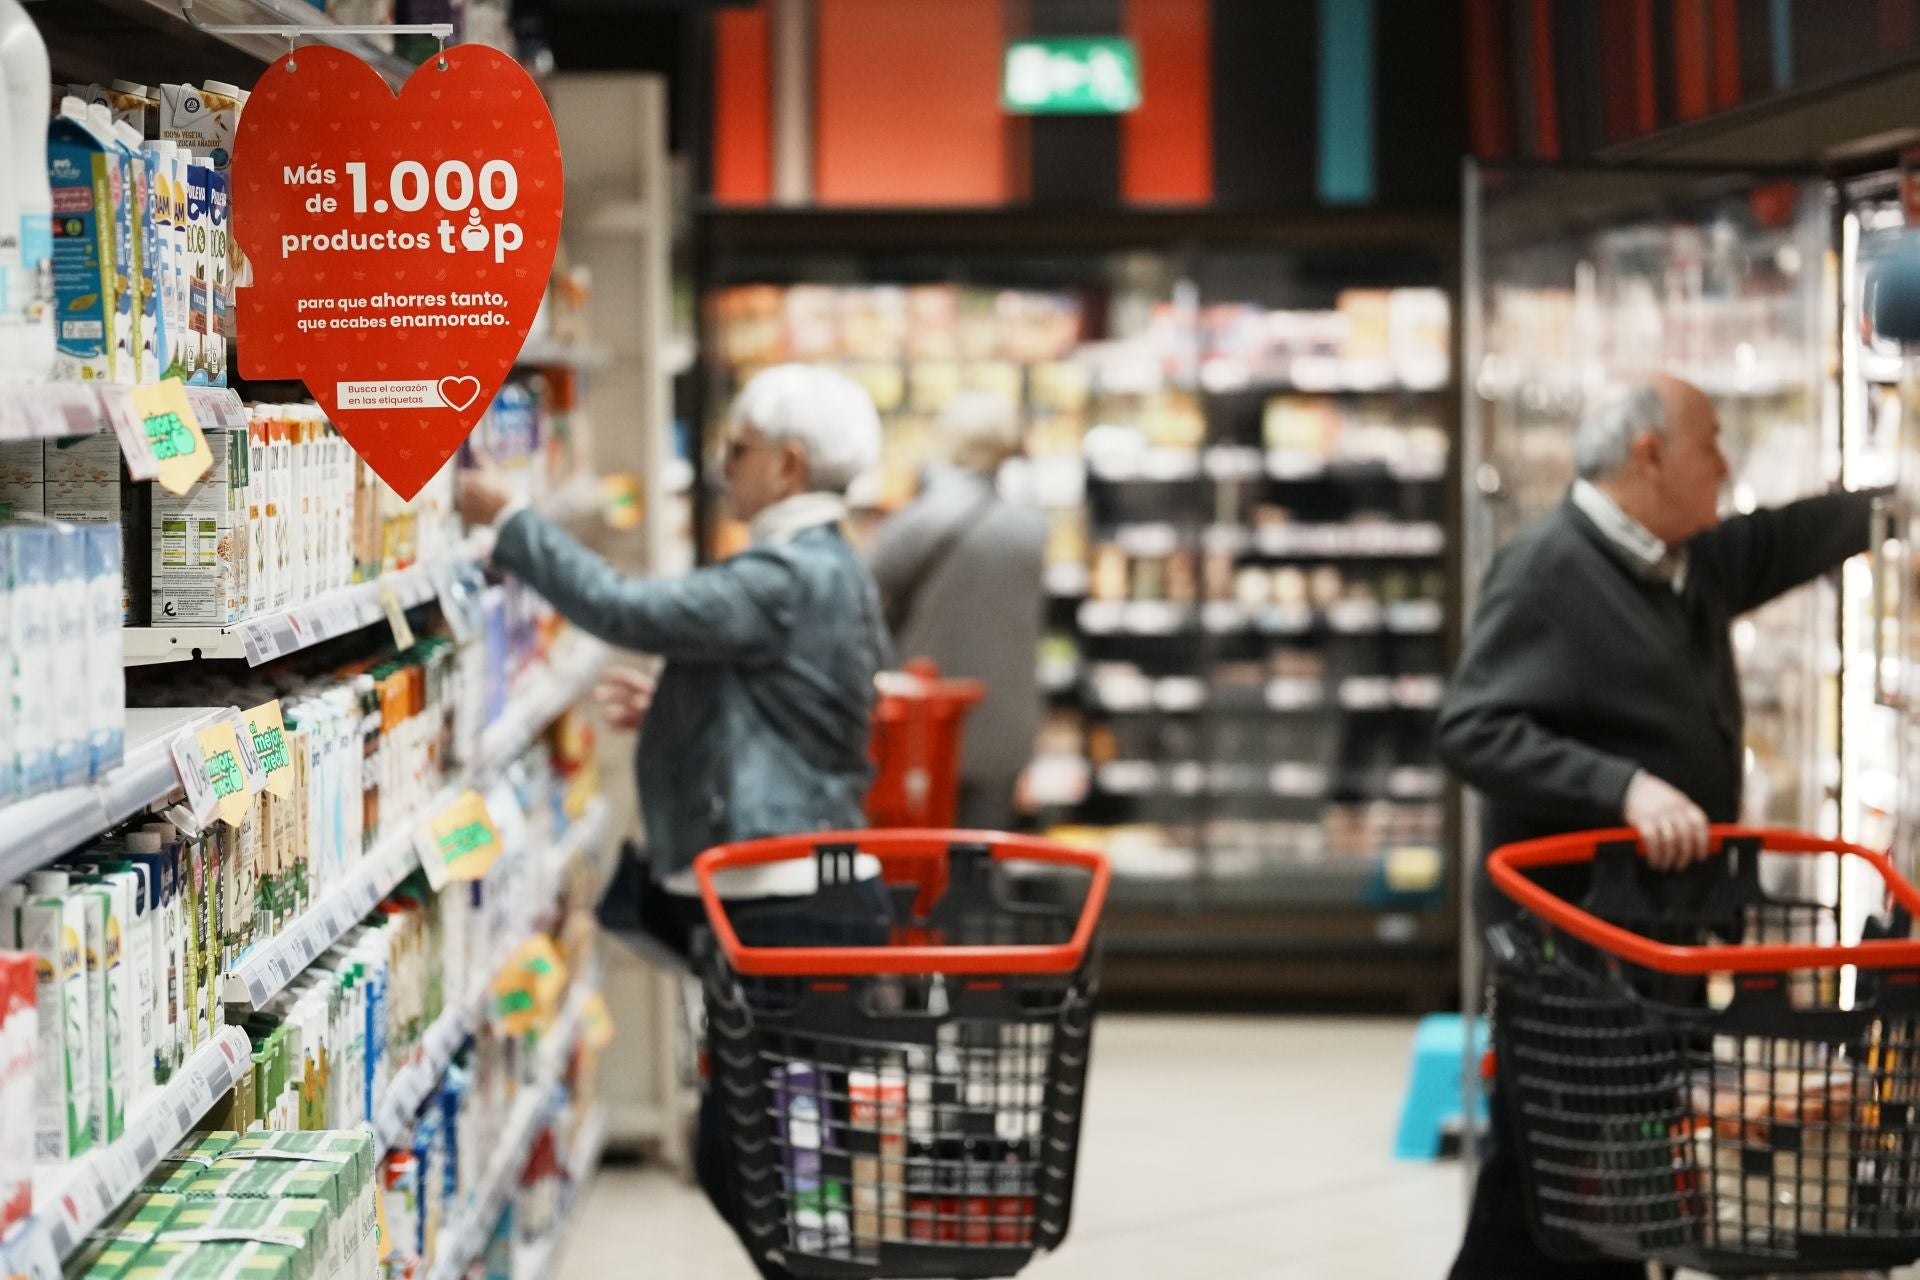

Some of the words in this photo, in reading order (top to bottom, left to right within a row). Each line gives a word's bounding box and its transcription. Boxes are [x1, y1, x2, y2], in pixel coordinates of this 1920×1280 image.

[283, 162, 337, 185] Más
[305, 193, 338, 213] de
[345, 159, 518, 213] 1.000
[281, 229, 431, 259] productos
[297, 297, 335, 313] para
[337, 297, 367, 312] que
[370, 292, 446, 308] ahorres
[450, 290, 509, 308] tanto,
[297, 318, 327, 333] que
[329, 315, 387, 329] acabes
[389, 310, 510, 328] enamorado.
[348, 384, 377, 394] Busca
[379, 384, 388, 393] el
[389, 383, 428, 393] corazón
[348, 397, 361, 405] en
[362, 396, 377, 405] las
[378, 395, 424, 406] etiquetas
